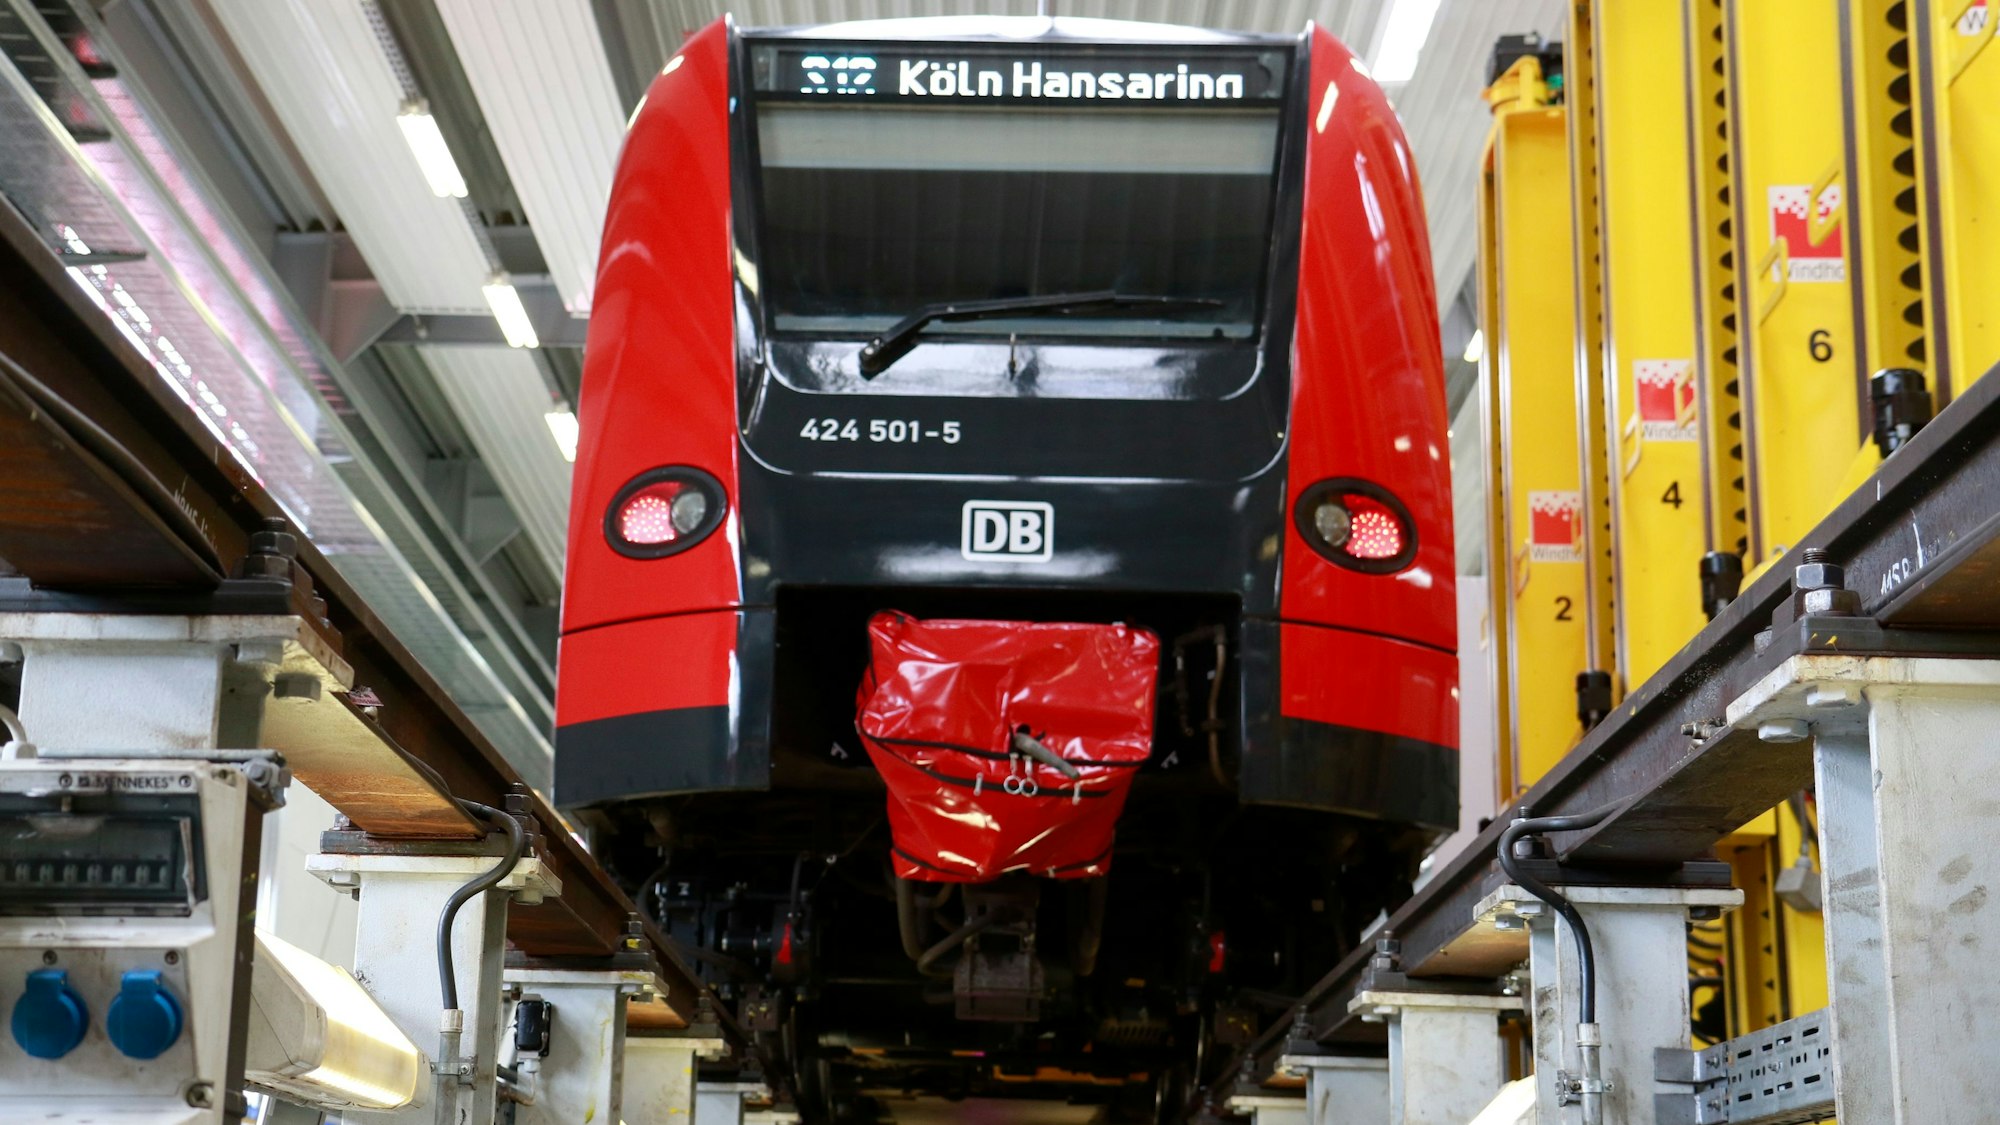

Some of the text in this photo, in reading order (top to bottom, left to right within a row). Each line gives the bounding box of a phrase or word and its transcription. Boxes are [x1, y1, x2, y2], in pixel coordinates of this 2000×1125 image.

[899, 60, 1003, 97] Köln
[1809, 329, 1833, 362] 6
[799, 418, 961, 444] 424 501-5
[1661, 481, 1682, 509] 4
[972, 509, 1043, 553] DB
[1555, 596, 1572, 621] 2
